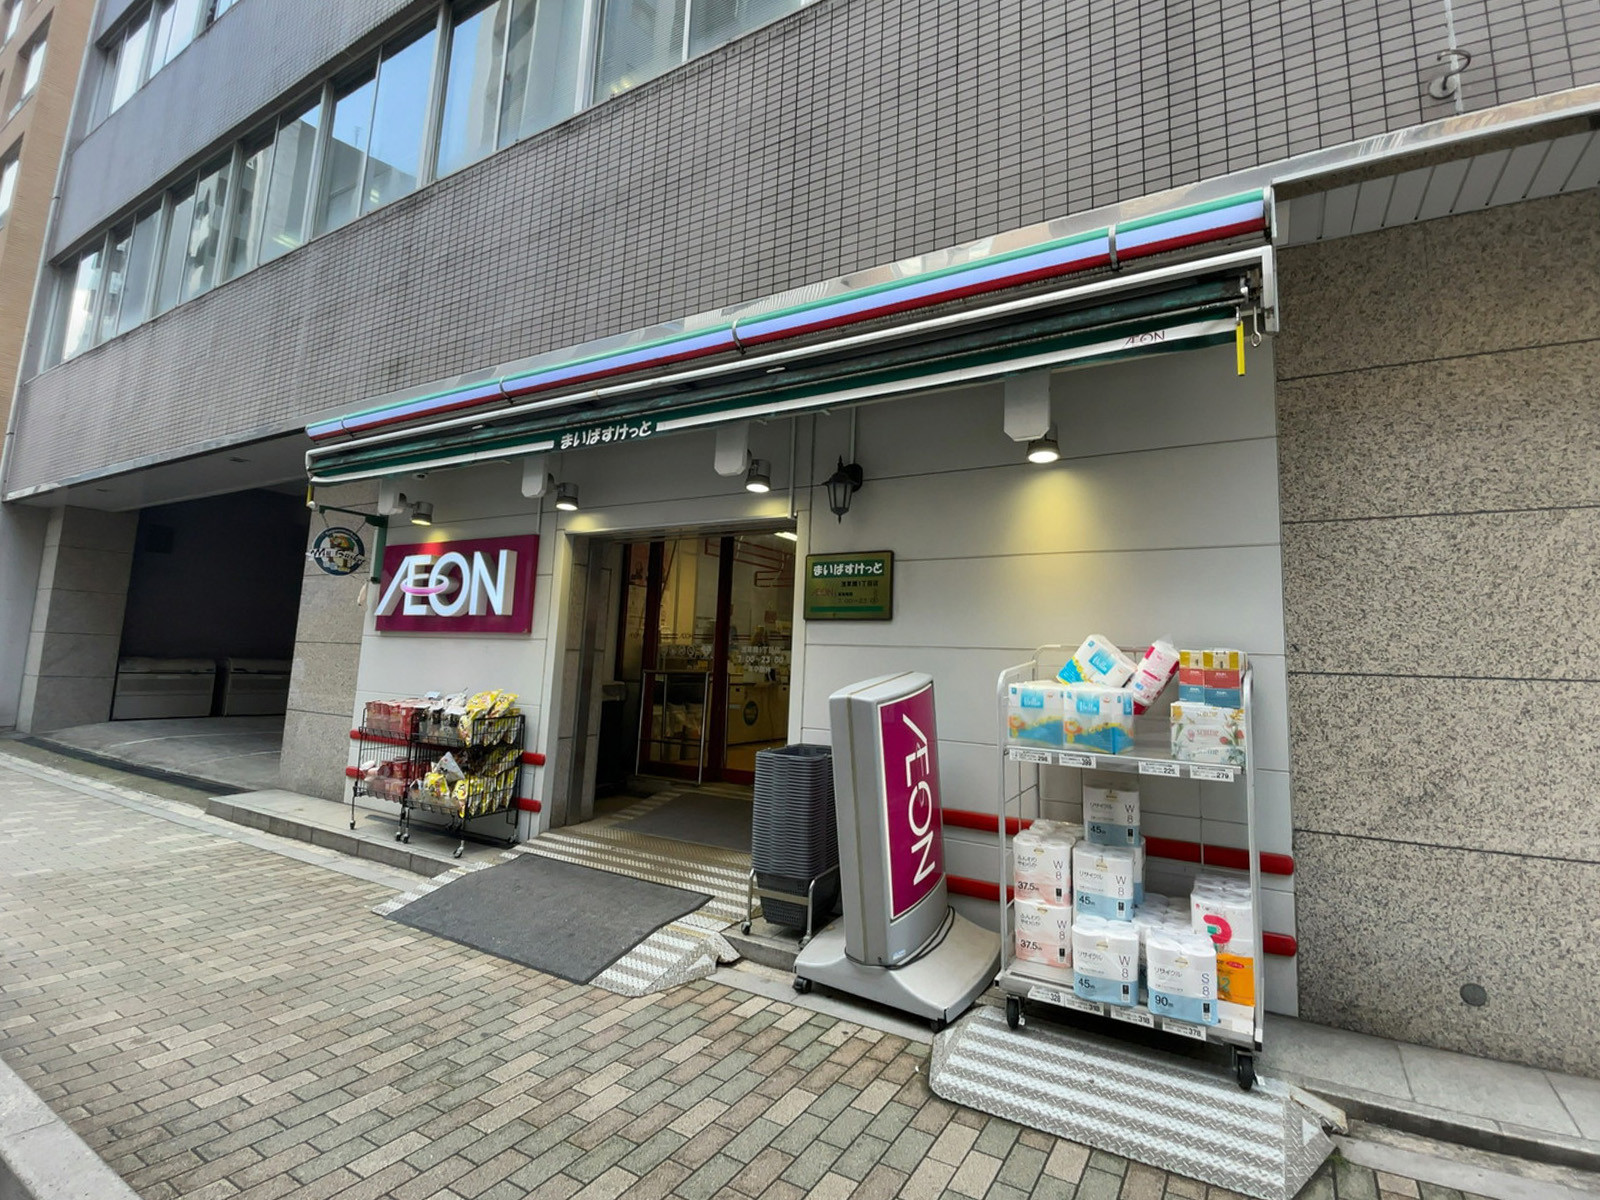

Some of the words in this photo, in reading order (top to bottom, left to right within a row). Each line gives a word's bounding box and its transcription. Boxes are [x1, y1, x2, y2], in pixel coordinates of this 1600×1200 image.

[560, 420, 652, 450] まいばすけっと
[813, 562, 883, 577] まいばすけっと
[736, 655, 784, 664] 700~2300
[1125, 804, 1135, 813] W
[1127, 815, 1134, 824] 8
[1053, 860, 1064, 869] W
[1055, 872, 1062, 880] 8
[1115, 875, 1127, 885] W
[1117, 887, 1125, 896] 8
[1057, 920, 1068, 929] W
[1059, 931, 1066, 940] 8
[1118, 955, 1131, 966] W
[1121, 968, 1129, 978] 8
[1153, 966, 1183, 978] リサイクル
[1201, 973, 1210, 985] S
[1202, 986, 1210, 997] 8
